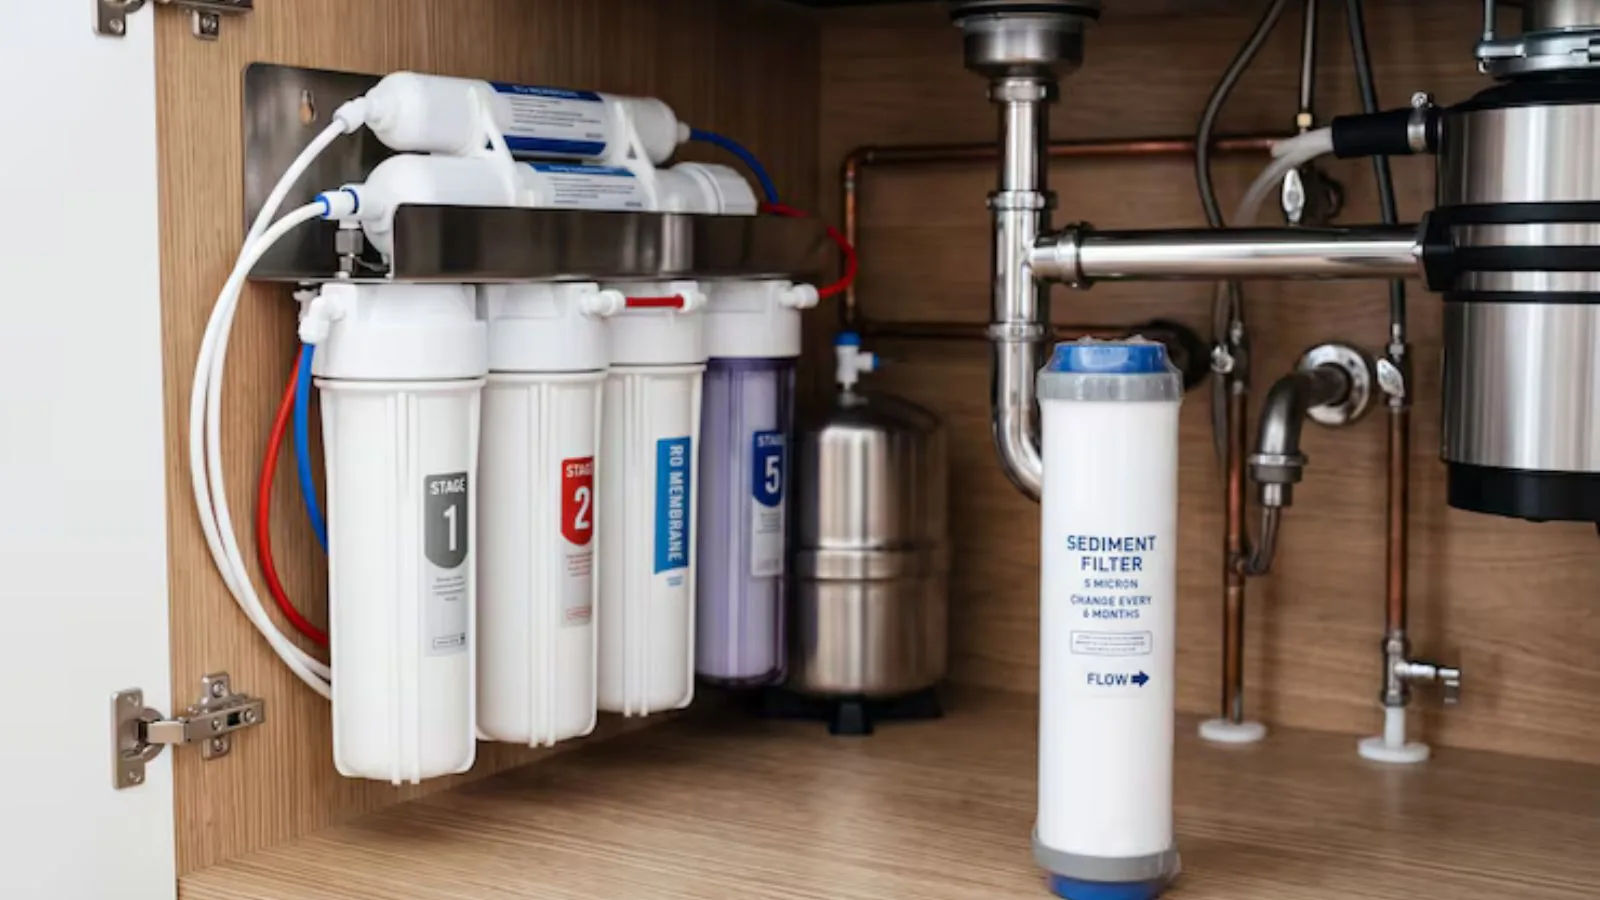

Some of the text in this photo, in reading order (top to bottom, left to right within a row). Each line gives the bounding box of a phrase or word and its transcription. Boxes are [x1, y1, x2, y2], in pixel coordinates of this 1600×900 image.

[669, 444, 684, 467] RO
[765, 455, 780, 494] 5
[430, 477, 466, 495] STAGE
[574, 486, 590, 530] 2
[668, 471, 684, 562] MEMBRANE
[443, 504, 457, 551] 1
[1067, 535, 1157, 552] SEDIMENT
[1081, 556, 1143, 572] FILTER
[1093, 579, 1139, 589] MICRON
[1070, 595, 1152, 606] CHANGE EVERY
[1083, 609, 1140, 619] 6 MONTHS
[1087, 672, 1129, 686] FLOW
